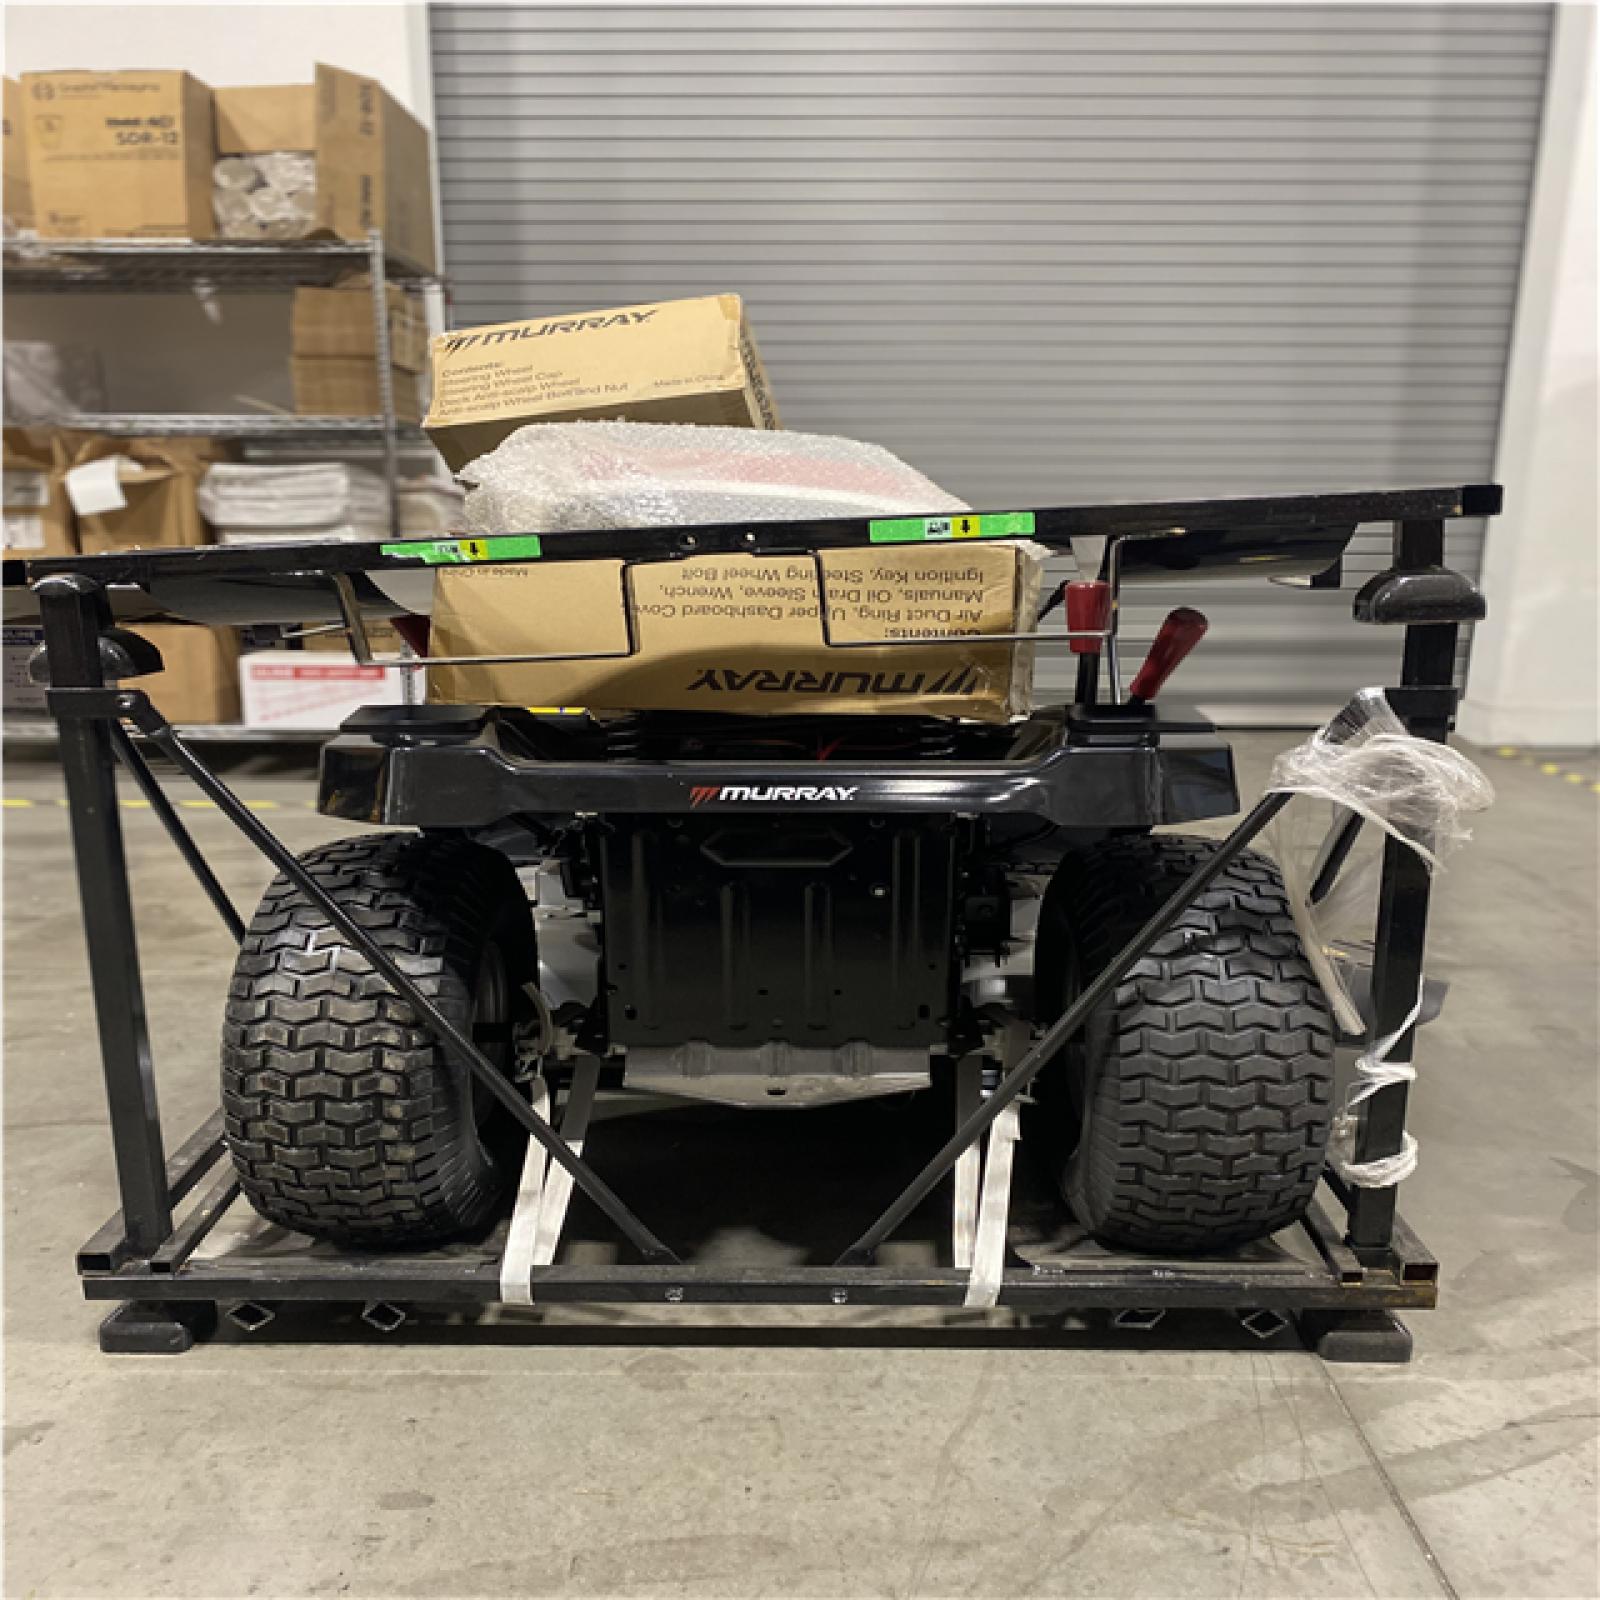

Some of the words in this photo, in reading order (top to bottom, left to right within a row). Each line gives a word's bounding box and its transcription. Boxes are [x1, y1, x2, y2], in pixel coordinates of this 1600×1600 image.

[481, 309, 659, 346] MURRAY
[494, 364, 534, 379] Wheel
[494, 374, 534, 389] Wheel
[539, 376, 581, 392] Wheel
[504, 391, 543, 407] Wheel
[604, 382, 629, 394] Nut
[681, 567, 718, 581] Bolt
[722, 567, 781, 582] Wheel
[869, 567, 909, 583] Key,
[914, 567, 984, 583] Ignition
[659, 584, 733, 600] Wrench,
[866, 589, 891, 603] Oil
[899, 587, 984, 604] Manuals,
[681, 604, 783, 620] Dashboard
[853, 604, 900, 623] Ring,
[906, 608, 951, 623] Duct
[954, 609, 984, 624] Air
[685, 669, 926, 694] MURRAY
[719, 785, 860, 801] MURRAY
